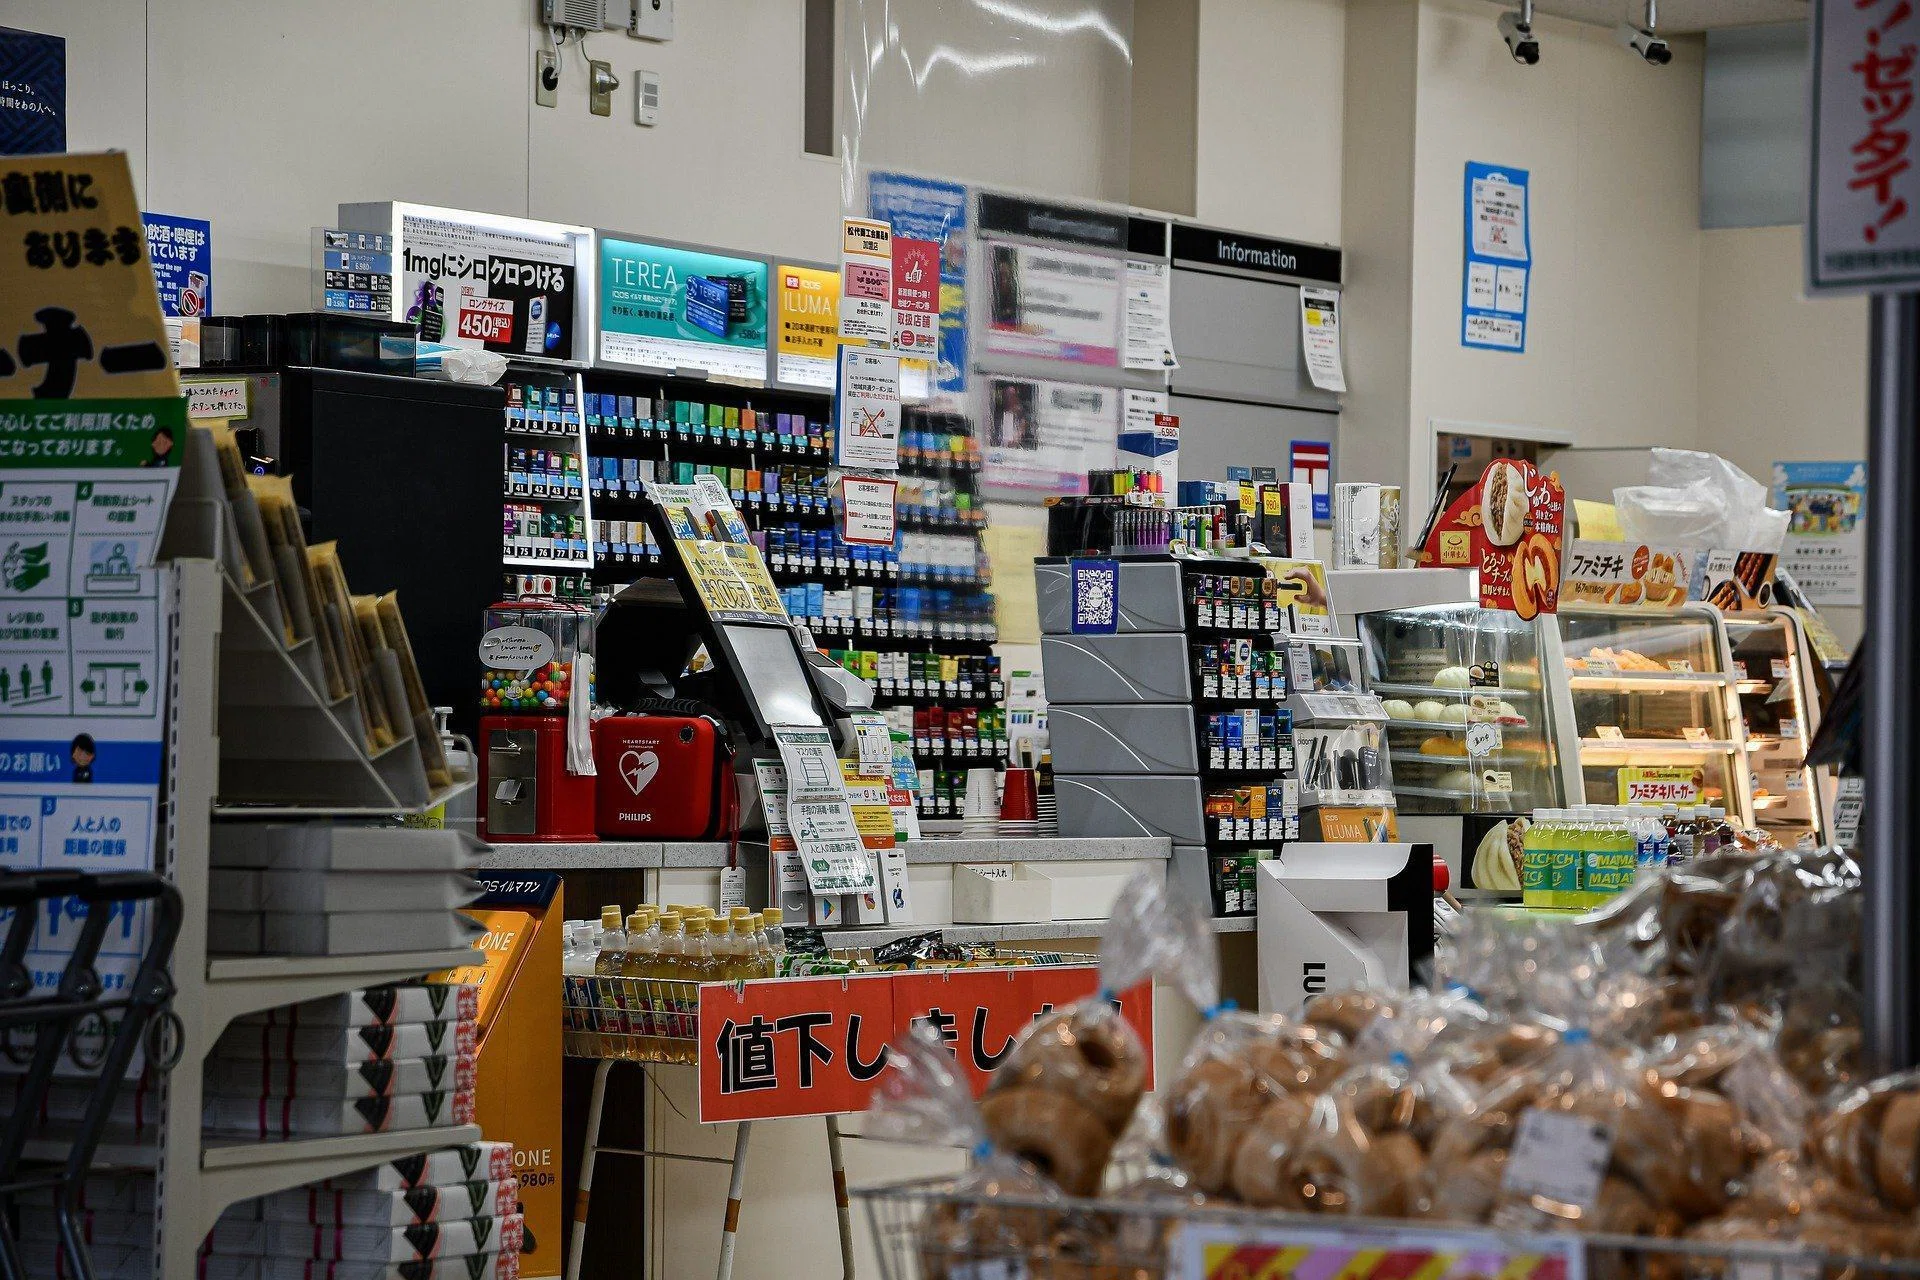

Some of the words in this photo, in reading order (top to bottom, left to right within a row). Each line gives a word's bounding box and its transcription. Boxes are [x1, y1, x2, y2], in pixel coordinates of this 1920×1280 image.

[3, 81, 34, 95] ほっこり。
[1218, 241, 1296, 270] Information
[612, 257, 677, 291] TEREA
[700, 286, 722, 303] TEREA
[469, 300, 505, 311] ロングサイズ
[784, 292, 832, 316] ILUMA
[897, 313, 931, 328] 取扱店舗
[590, 426, 597, 434] 11
[607, 427, 615, 435] 12
[625, 429, 633, 437] 13
[643, 430, 651, 438] 14
[660, 431, 668, 439] 15
[680, 433, 688, 441] 16
[696, 435, 704, 443] 17
[713, 437, 721, 445] 18
[730, 439, 738, 447] 19
[764, 443, 773, 451] 21
[782, 445, 791, 453] 22
[515, 484, 524, 492] 41
[592, 489, 601, 497] 45
[628, 491, 637, 499] 47
[1205, 492, 1223, 502] with
[11, 496, 52, 507] スタッフの
[769, 504, 778, 512] 55
[786, 505, 795, 513] 56
[802, 506, 810, 514] 57
[817, 507, 826, 515] 58
[1535, 522, 1558, 533] 本格肉まん
[520, 548, 529, 556] 75
[539, 549, 548, 557] 76
[575, 551, 584, 559] 78
[596, 552, 606, 561] 79
[615, 554, 625, 562] 80
[632, 555, 640, 563] 81
[650, 555, 659, 563] 82
[1443, 551, 1467, 559] 中華まん
[790, 565, 799, 573] 90
[823, 567, 832, 575] 92
[839, 568, 847, 576] 93
[857, 569, 866, 577] 94
[872, 570, 881, 578] 95
[889, 571, 897, 579] 96
[1572, 554, 1623, 579] ファミチキ
[1482, 584, 1511, 597] 濃厚ピザまん
[826, 627, 838, 635] 126
[861, 629, 872, 637] 128
[877, 629, 888, 637] 129
[898, 689, 909, 697] 164
[928, 690, 940, 698] 166
[946, 690, 957, 698] 167
[961, 691, 972, 699] 168
[975, 691, 986, 699] 169
[991, 691, 1003, 699] 170
[918, 748, 929, 756] 199
[933, 748, 944, 756] 200
[967, 749, 978, 757] 202
[981, 748, 992, 756] 203
[997, 749, 1008, 757] 204
[1630, 784, 1694, 799] ファミチキバーガー
[619, 812, 651, 821] PHILIPS
[923, 807, 934, 815] 233
[938, 807, 950, 815] 234
[72, 816, 121, 832] 人と人の
[1328, 825, 1362, 839] ILUMA
[783, 865, 803, 873] amazon
[971, 868, 1007, 878] シート入れ
[479, 931, 515, 951] ONE
[514, 1149, 551, 1166] ONE
